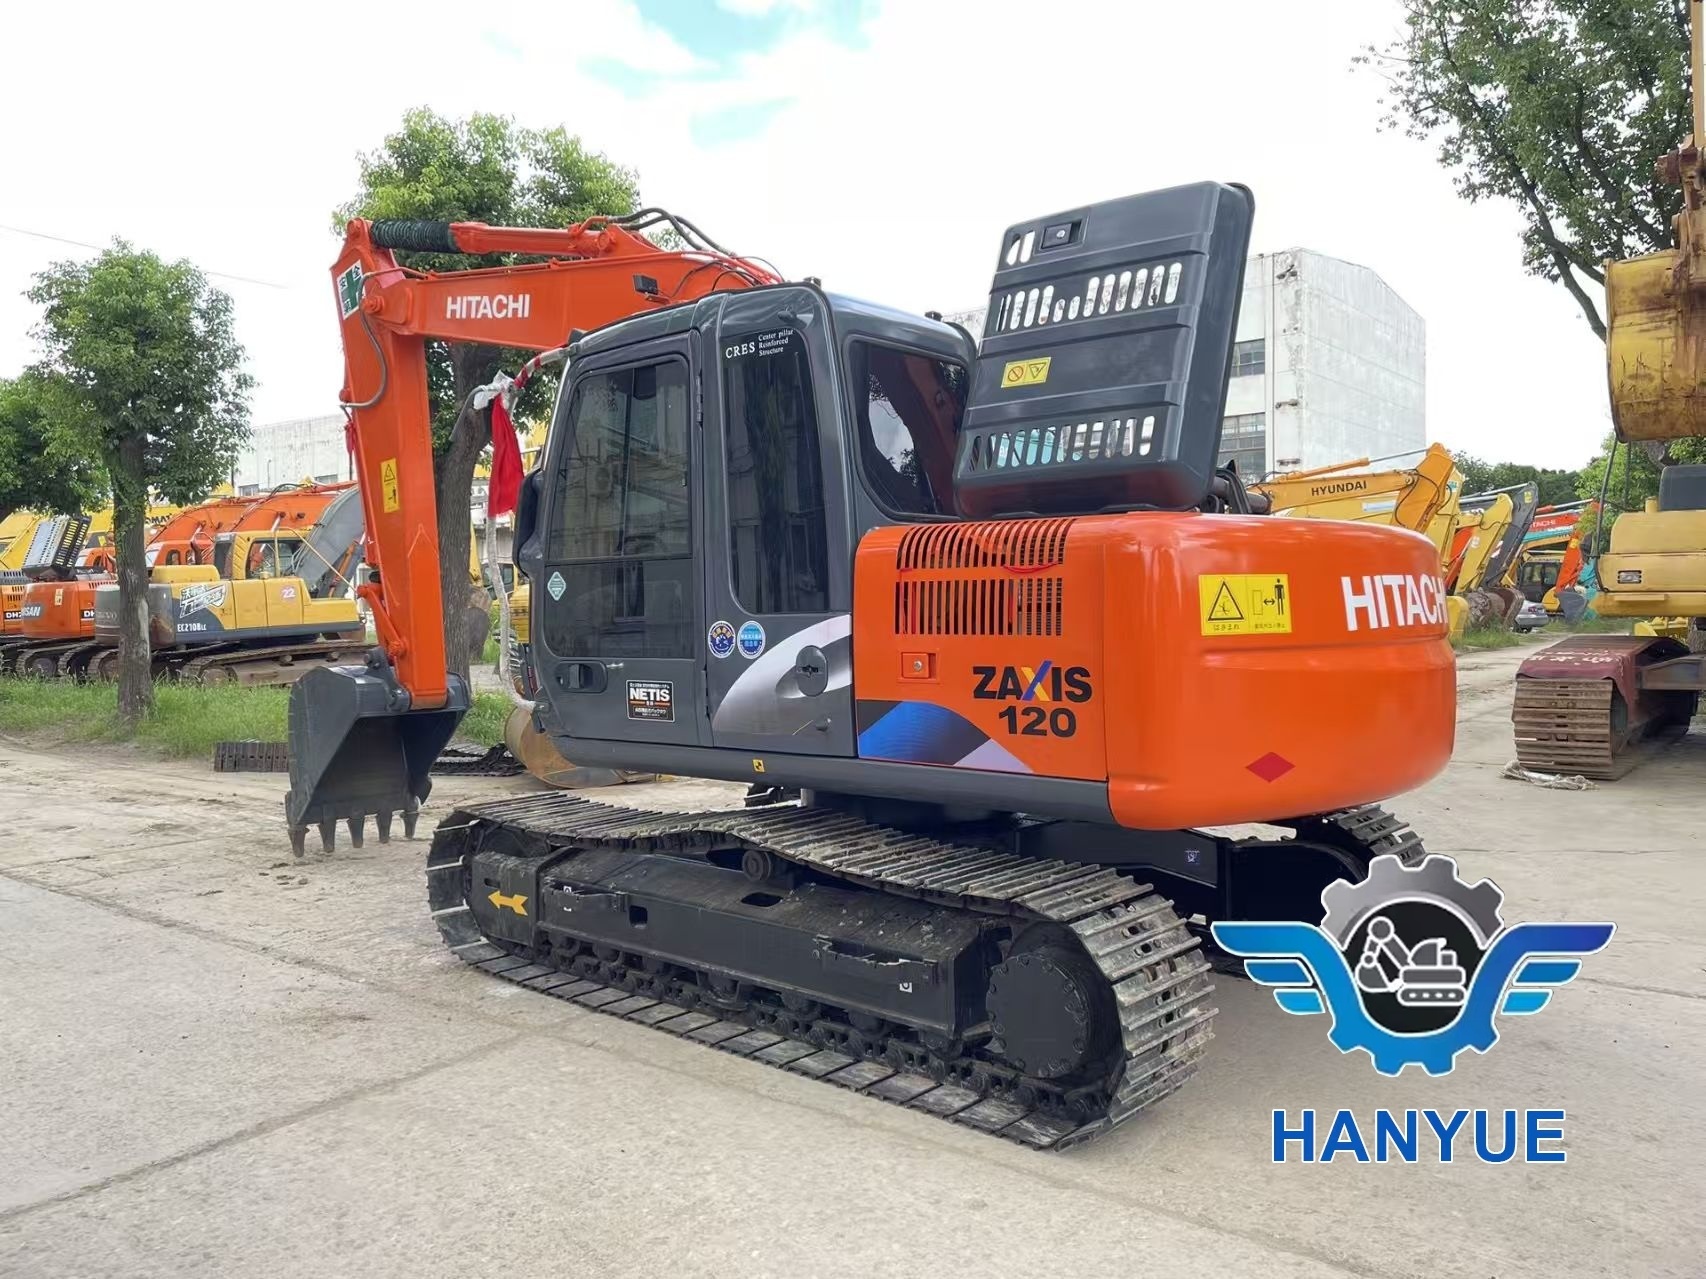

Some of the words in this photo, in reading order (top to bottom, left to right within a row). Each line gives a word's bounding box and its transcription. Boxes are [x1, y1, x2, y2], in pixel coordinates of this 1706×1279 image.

[446, 293, 531, 319] HITACHI
[758, 332, 776, 341] Center
[778, 328, 794, 339] pillar
[725, 341, 756, 359] CRES
[758, 337, 789, 349] Reinforced
[759, 346, 784, 357] Structure
[1311, 480, 1367, 496] HYUNDAI
[281, 588, 296, 598] 22
[973, 660, 1092, 703] ZAXIS
[630, 688, 670, 701] NETIS
[999, 705, 1077, 738] 120
